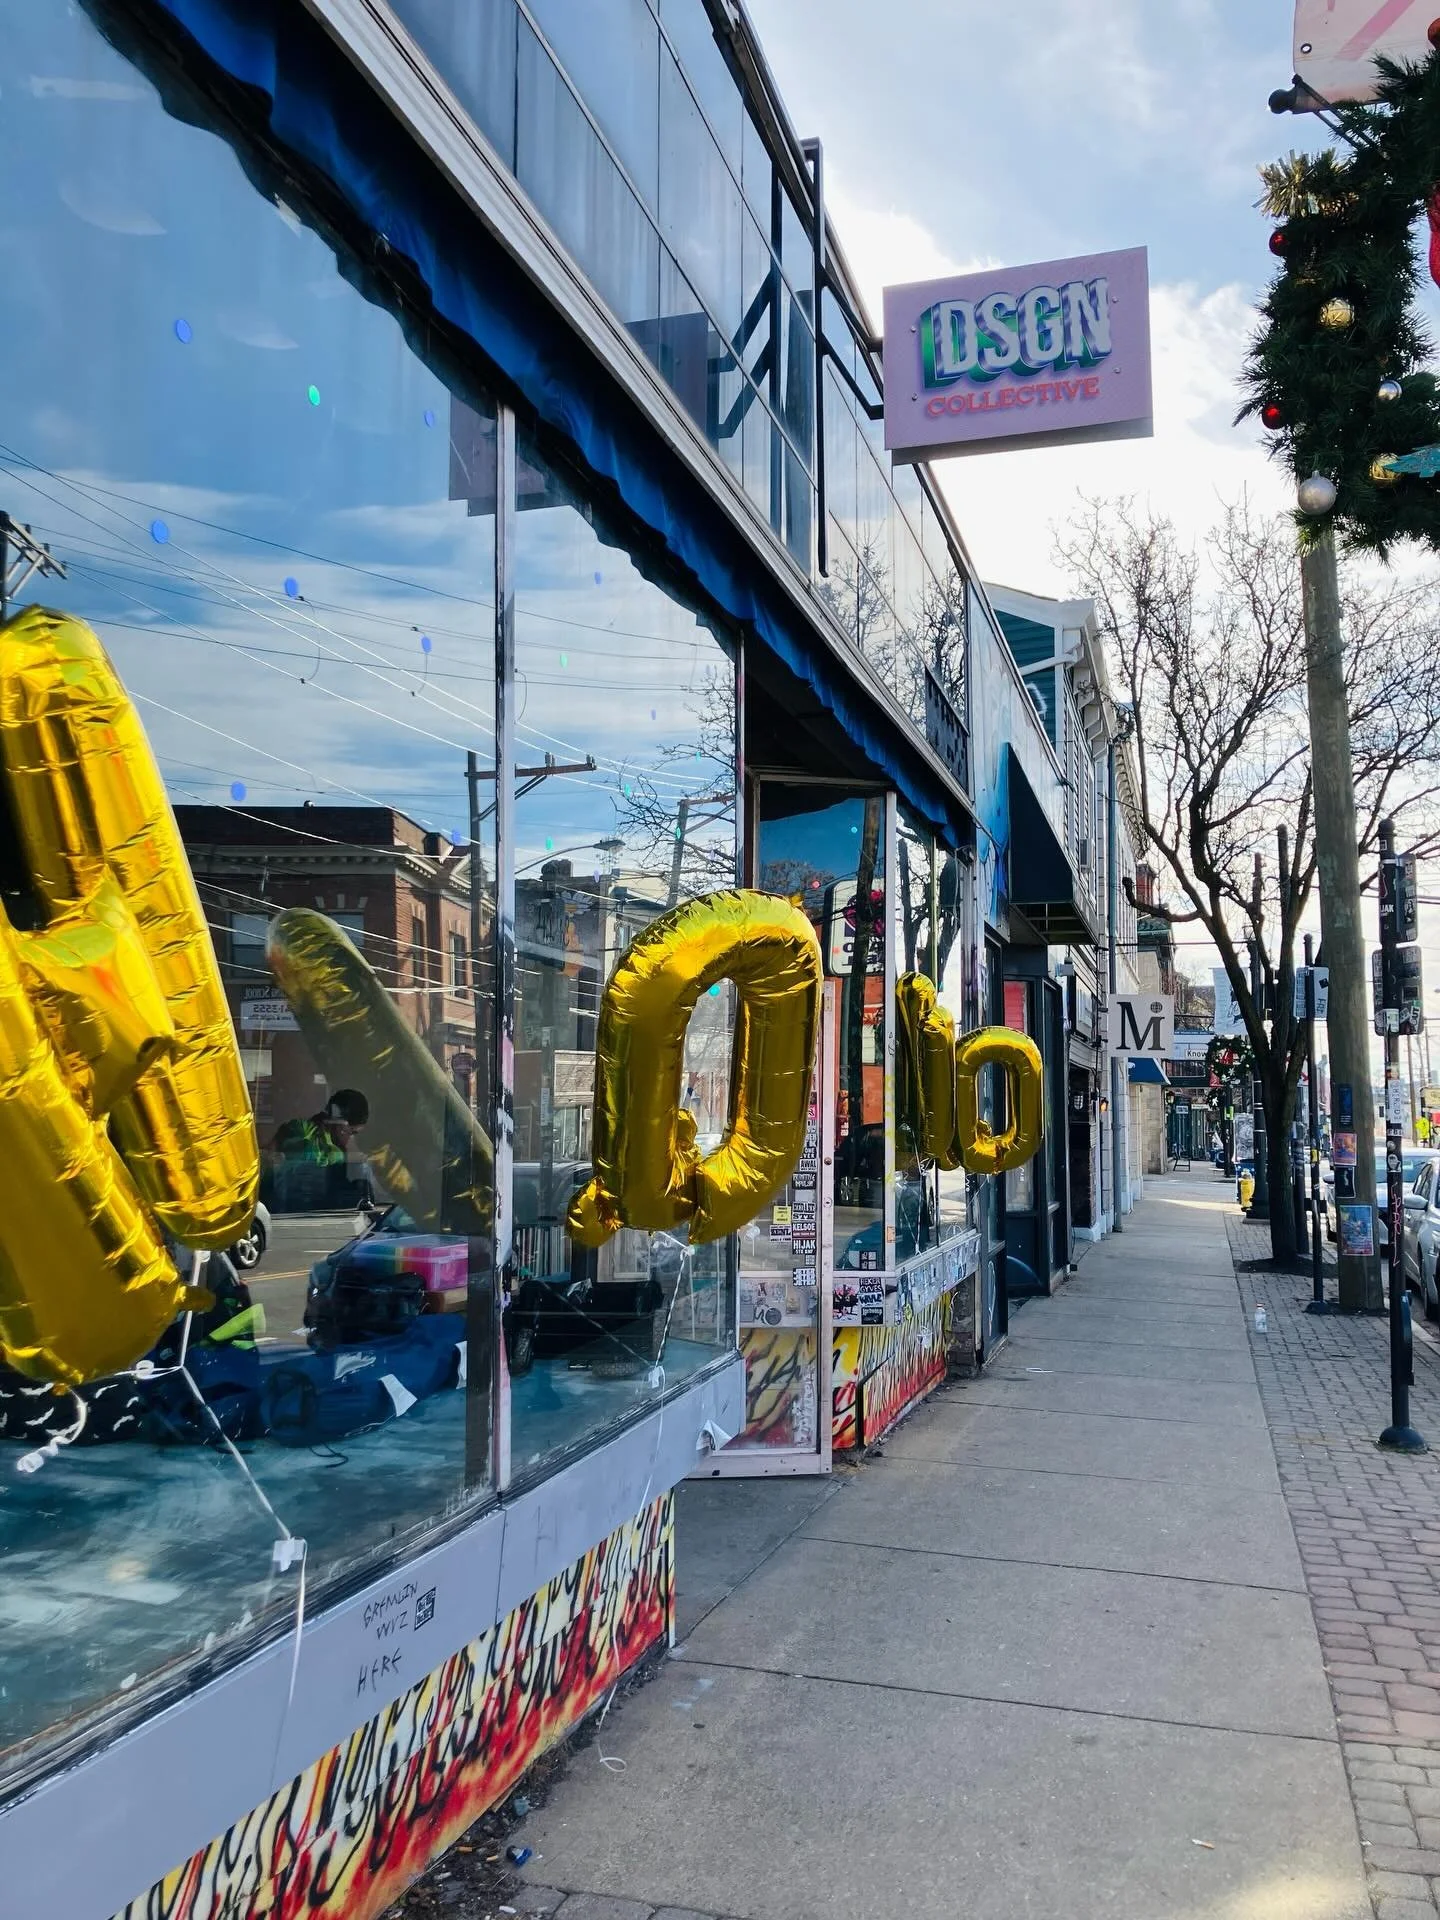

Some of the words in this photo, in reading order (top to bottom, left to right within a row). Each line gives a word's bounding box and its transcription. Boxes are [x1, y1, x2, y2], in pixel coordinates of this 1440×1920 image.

[921, 278, 1112, 388] DSGN
[927, 377, 1100, 417] COLLECTIVE
[793, 1223, 816, 1231] KELSOE
[793, 1239, 816, 1250] HIJAK
[356, 1648, 402, 1698] HERE
